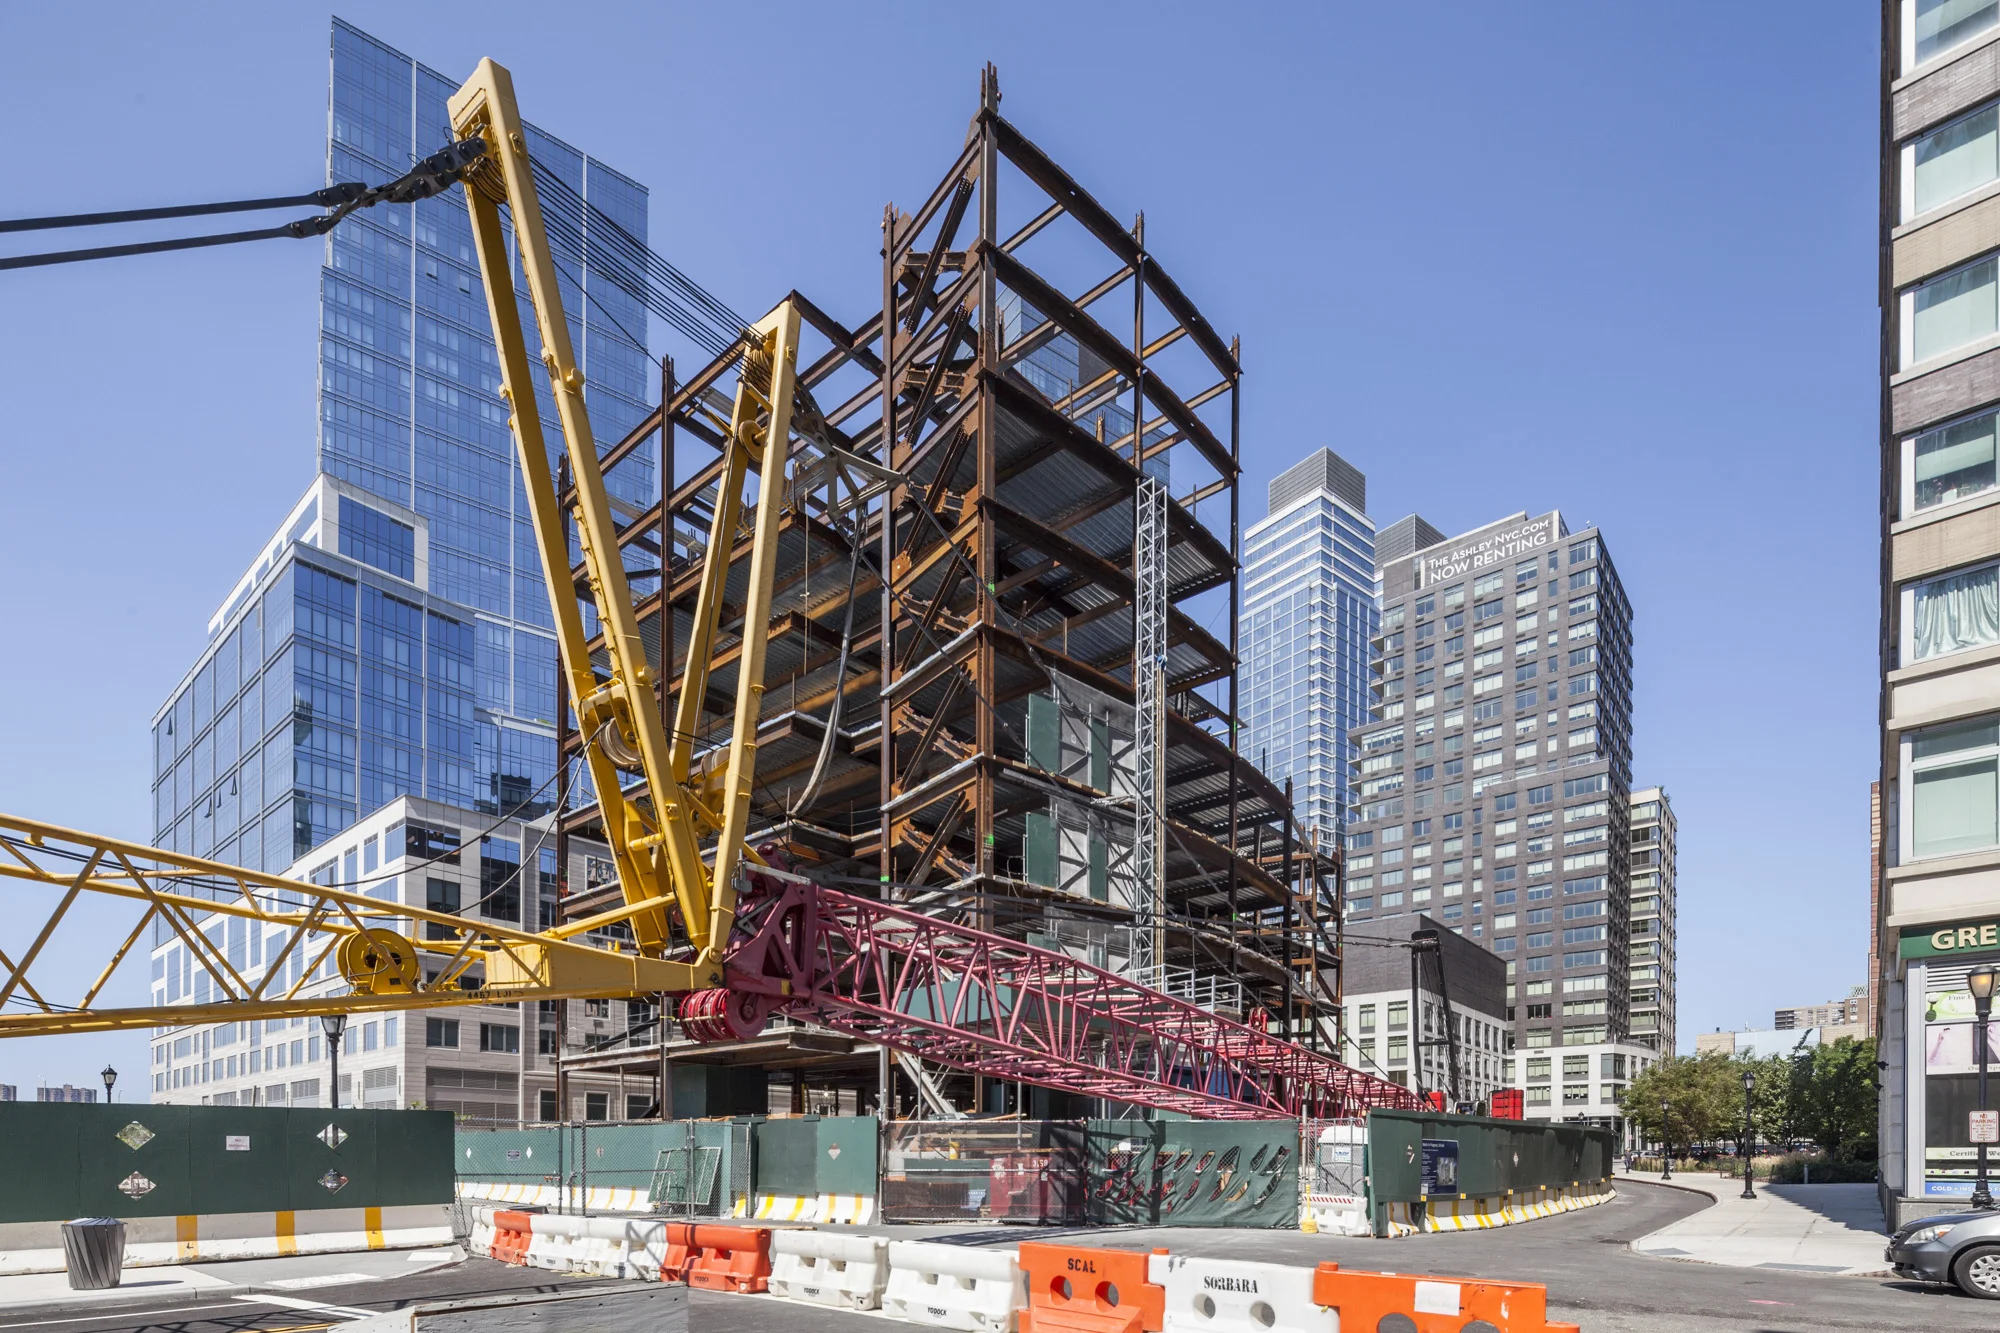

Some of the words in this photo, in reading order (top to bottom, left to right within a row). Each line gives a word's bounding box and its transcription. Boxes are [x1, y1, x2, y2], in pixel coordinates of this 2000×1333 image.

[1430, 559, 1469, 584] NOW
[1473, 532, 1547, 568] RENTING
[1931, 924, 1998, 951] GRE
[1067, 1257, 1096, 1274] SCAL
[1203, 1275, 1259, 1294] SORBARA
[927, 1306, 947, 1316] YODOCK
